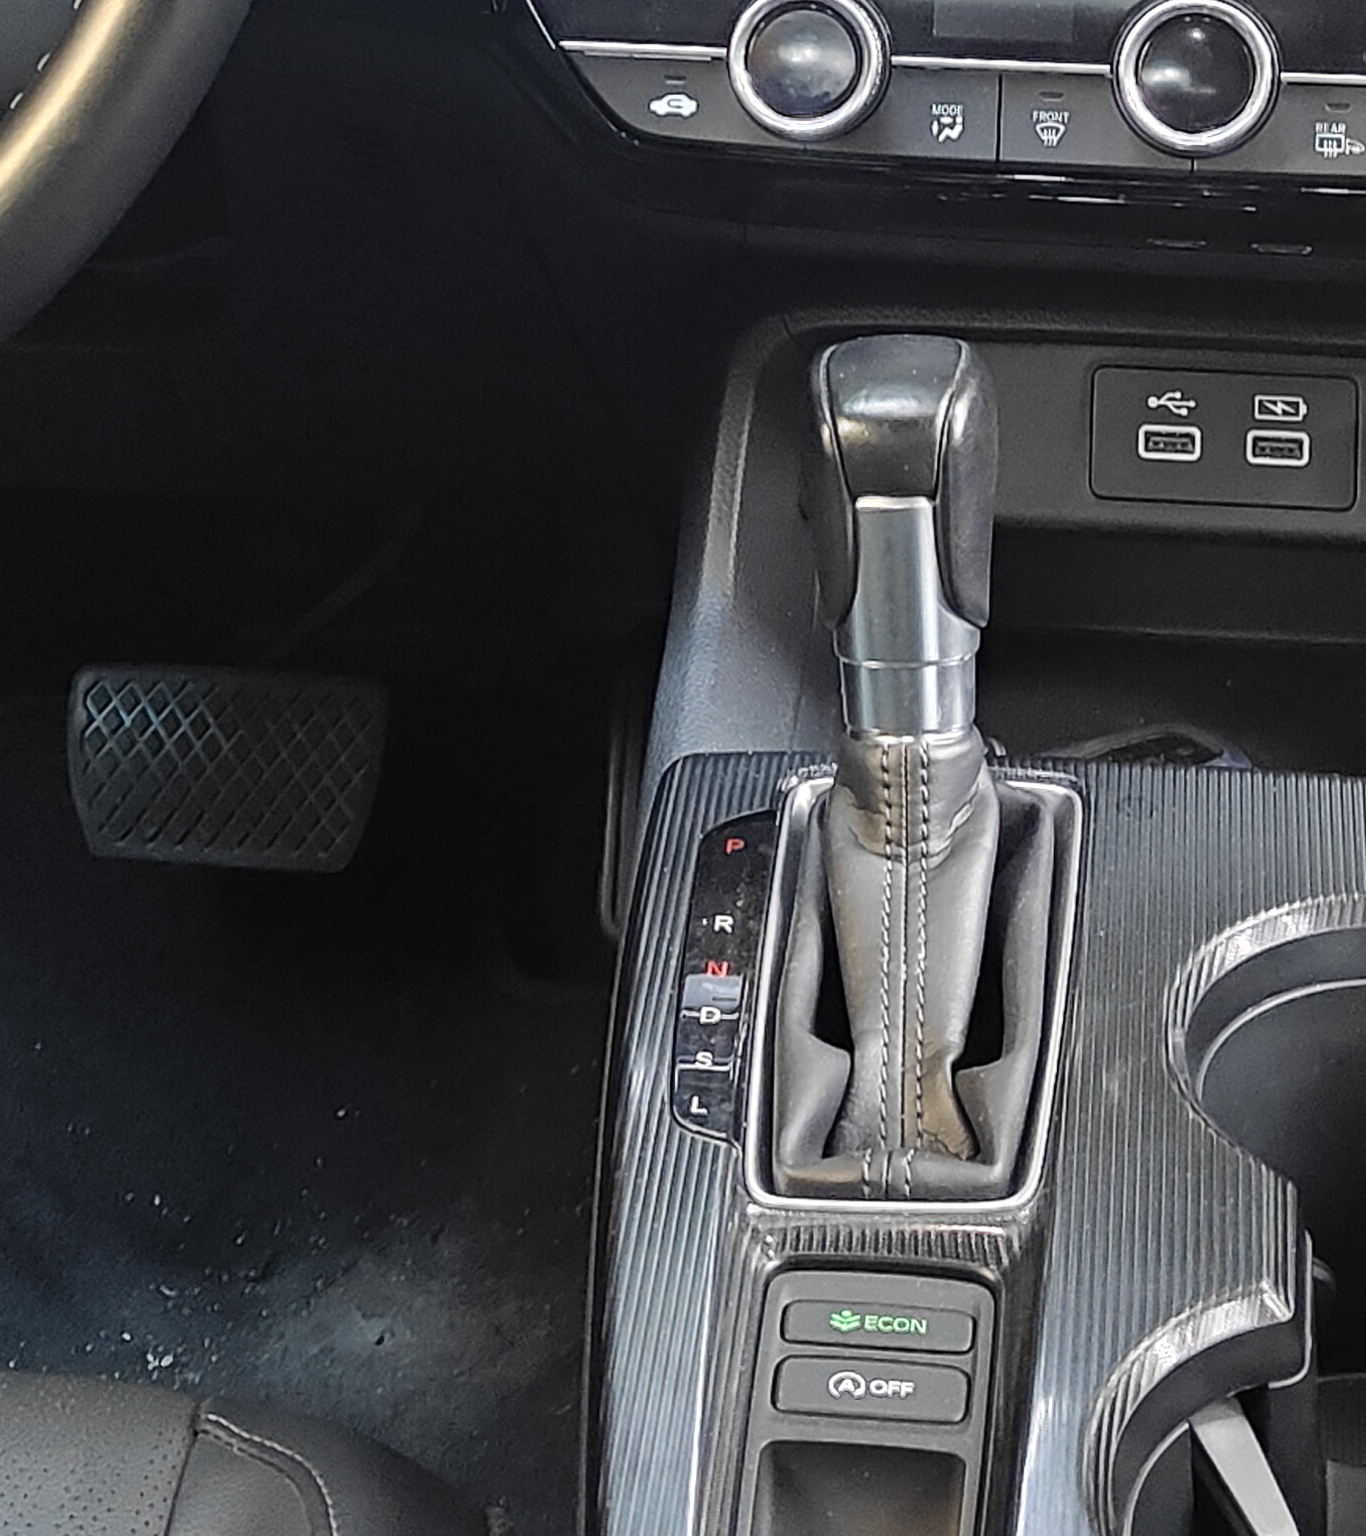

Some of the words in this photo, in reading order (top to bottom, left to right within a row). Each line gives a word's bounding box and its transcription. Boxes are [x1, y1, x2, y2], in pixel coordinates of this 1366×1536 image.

[932, 103, 964, 115] MODE
[1032, 111, 1070, 123] FRONT
[1315, 122, 1346, 134] REAR
[725, 838, 745, 855] P
[713, 914, 734, 933] R
[706, 960, 729, 978] N
[700, 1006, 721, 1023] D
[695, 1051, 714, 1066] S
[690, 1096, 708, 1115] L
[864, 1314, 927, 1335] ECON
[868, 1379, 916, 1399] OFF
